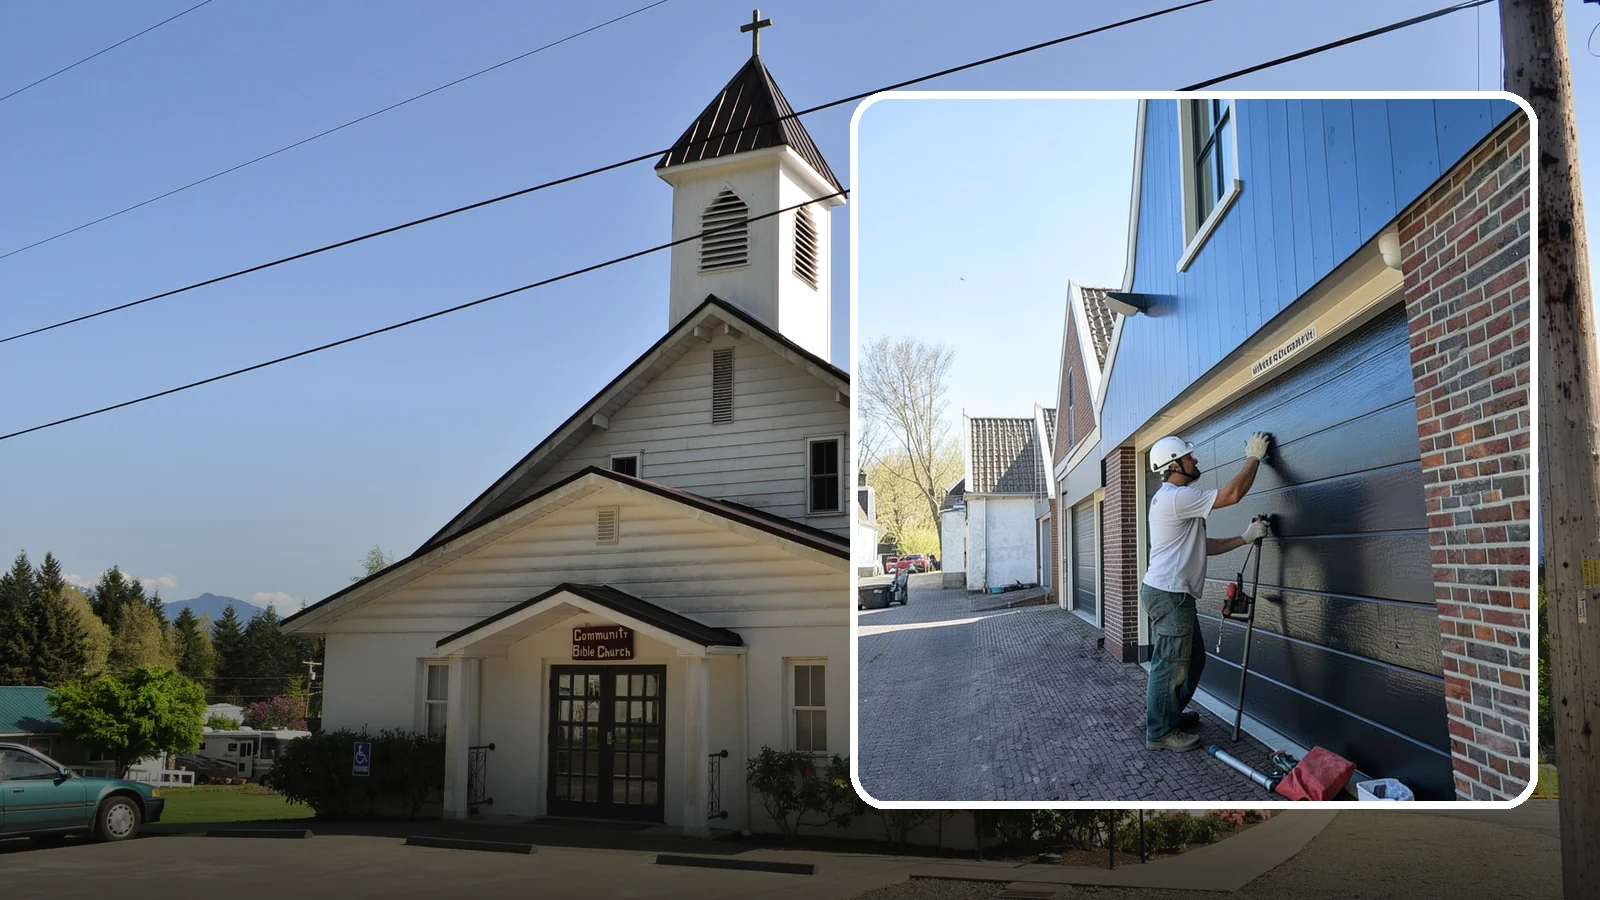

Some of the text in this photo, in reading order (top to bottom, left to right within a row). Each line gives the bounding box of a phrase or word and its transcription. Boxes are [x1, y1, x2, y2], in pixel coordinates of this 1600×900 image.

[574, 627, 628, 641] Community
[572, 644, 631, 658] Bible Church
